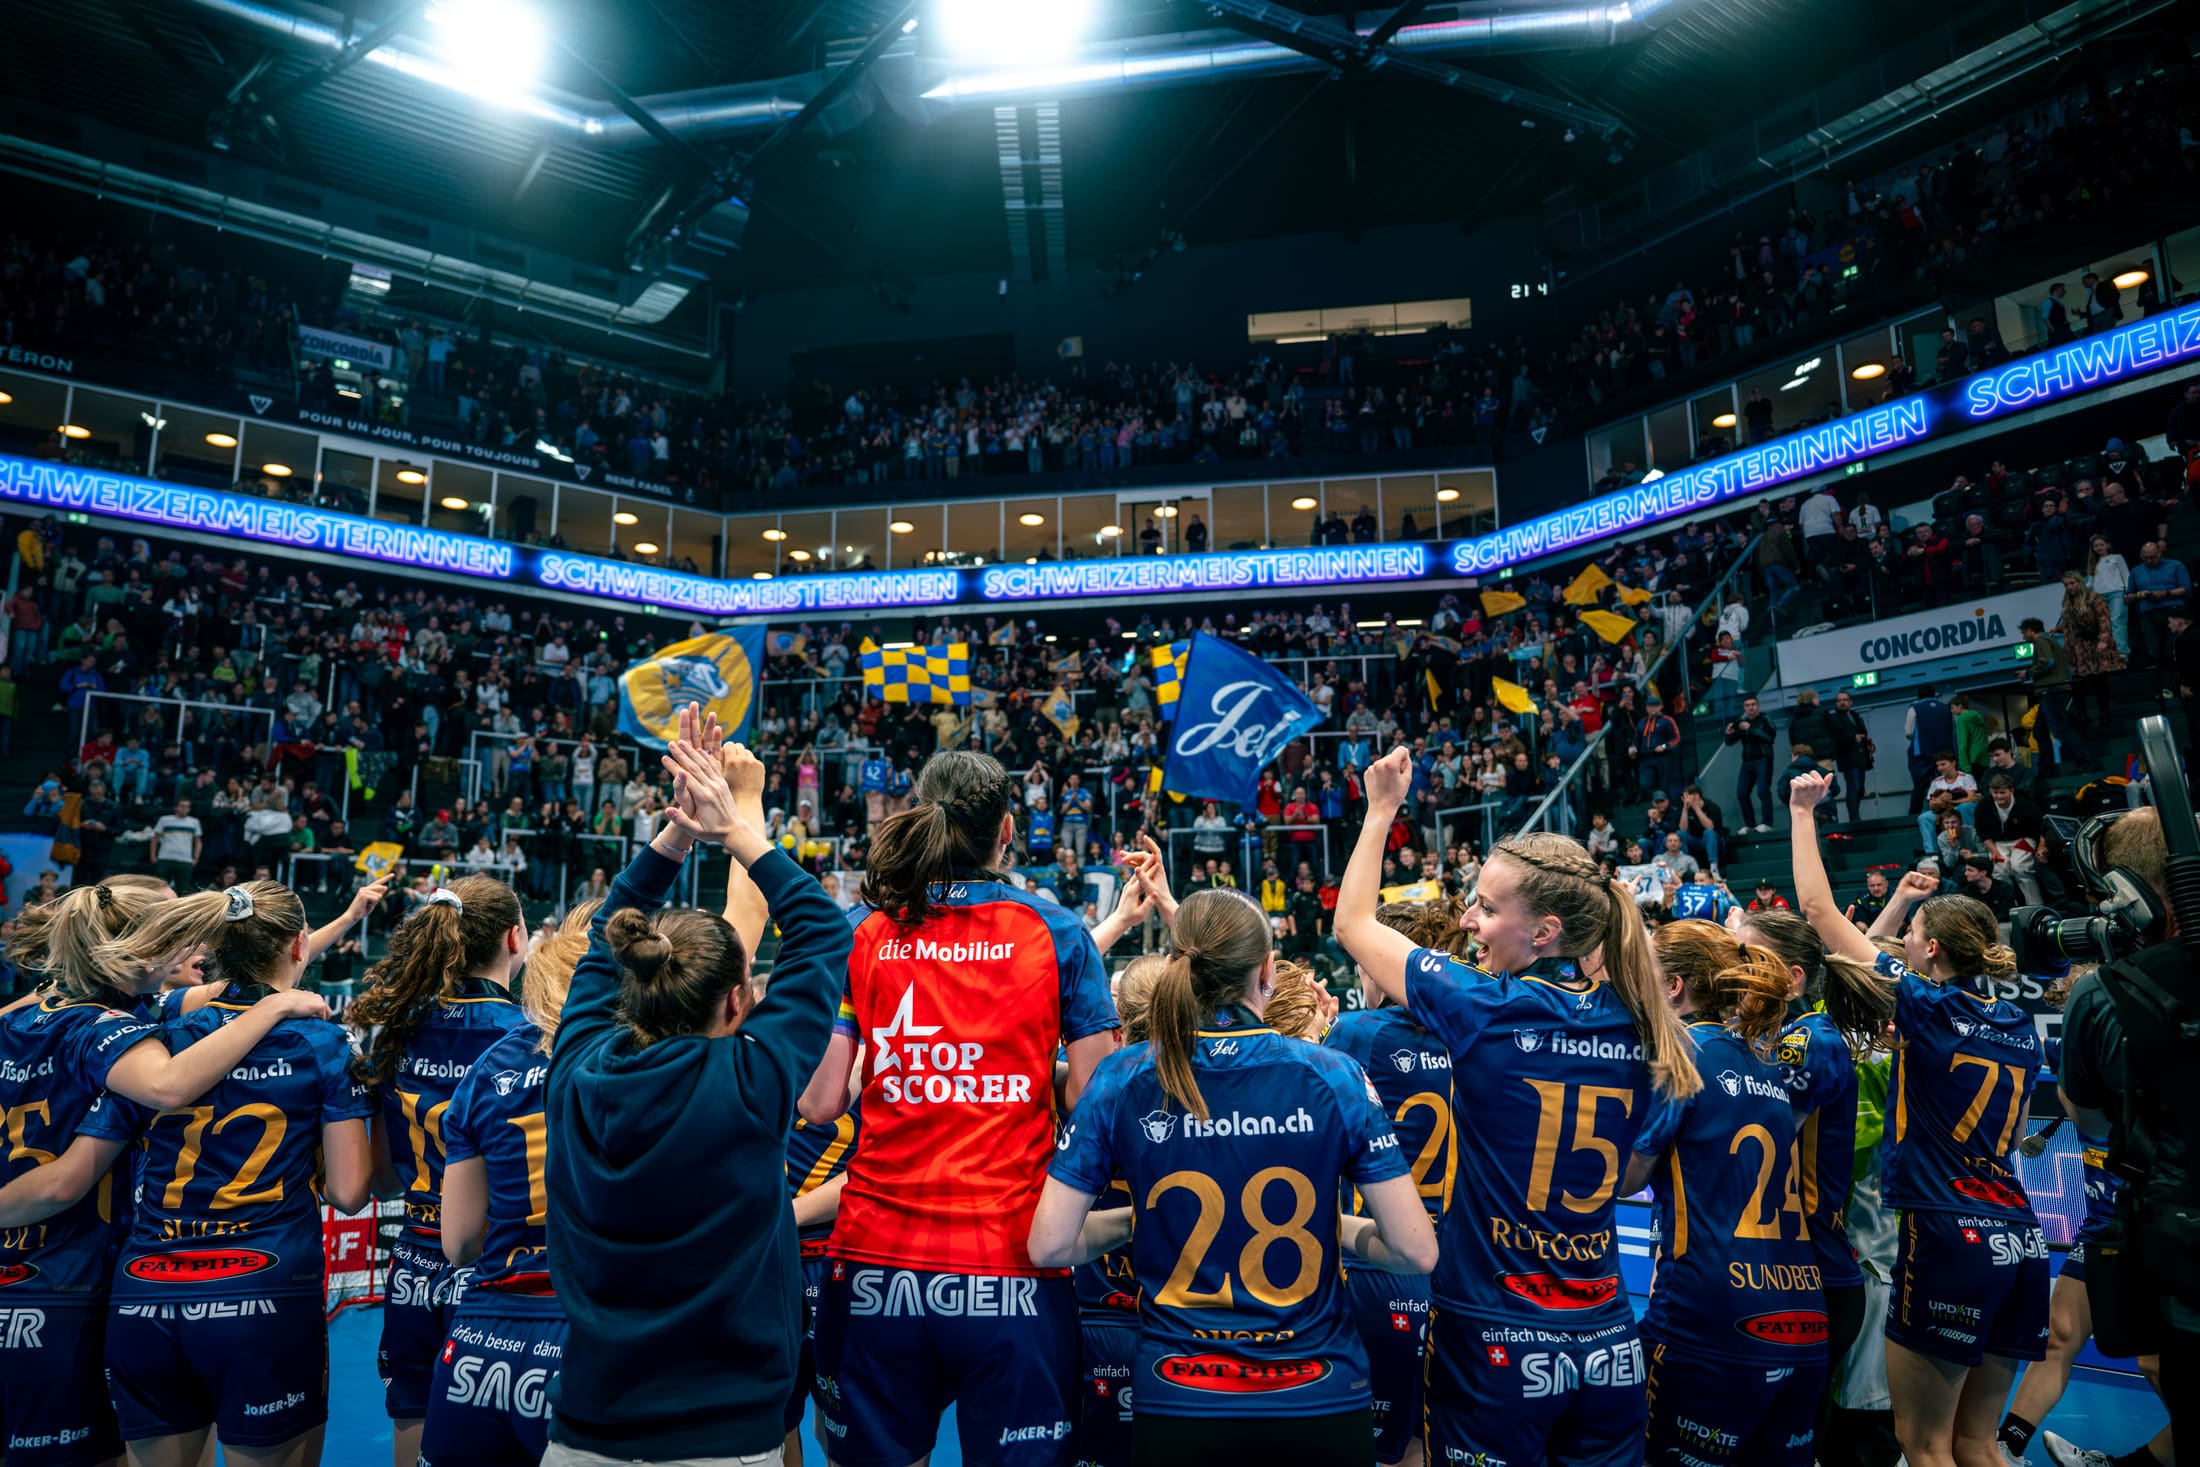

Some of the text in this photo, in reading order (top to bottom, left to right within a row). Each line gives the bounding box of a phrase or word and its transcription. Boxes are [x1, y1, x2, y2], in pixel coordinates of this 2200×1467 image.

[299, 409, 343, 428] POUR
[347, 419, 369, 434] UN
[421, 435, 463, 454] POUR
[466, 444, 541, 470] TOUJOURS
[1453, 399, 1928, 575] SCHWEIZERMEISTERINNEN
[0, 459, 511, 577] HWEIZERMEISTERINNEN
[541, 553, 958, 611] SCHWEIZERMEISTERINNEN
[984, 545, 1425, 598] SCHWEIZERMEISTERINNEN
[1861, 609, 2006, 664] CONCORDIA
[1683, 895, 1707, 917] 37
[878, 938, 1015, 963] die Mobiliar
[903, 1042, 983, 1071] TOP
[882, 1075, 1031, 1104] SCORER
[1949, 1052, 2027, 1158] 71
[1183, 1107, 1314, 1138] fisolan.ch
[1522, 1077, 1634, 1214] 15
[149, 1102, 288, 1210] 72
[1729, 1123, 1812, 1241] 24
[1146, 1166, 1324, 1309] 28
[136, 1256, 259, 1273] FAT PIPE
[850, 1269, 1039, 1317] SAGER
[1482, 1328, 1534, 1343] einfach
[1757, 1322, 1796, 1334] FAT
[1093, 1365, 1130, 1377] einfach
[1172, 1362, 1315, 1378] FAT PIPE
[1677, 1416, 1739, 1447] UPDATE
